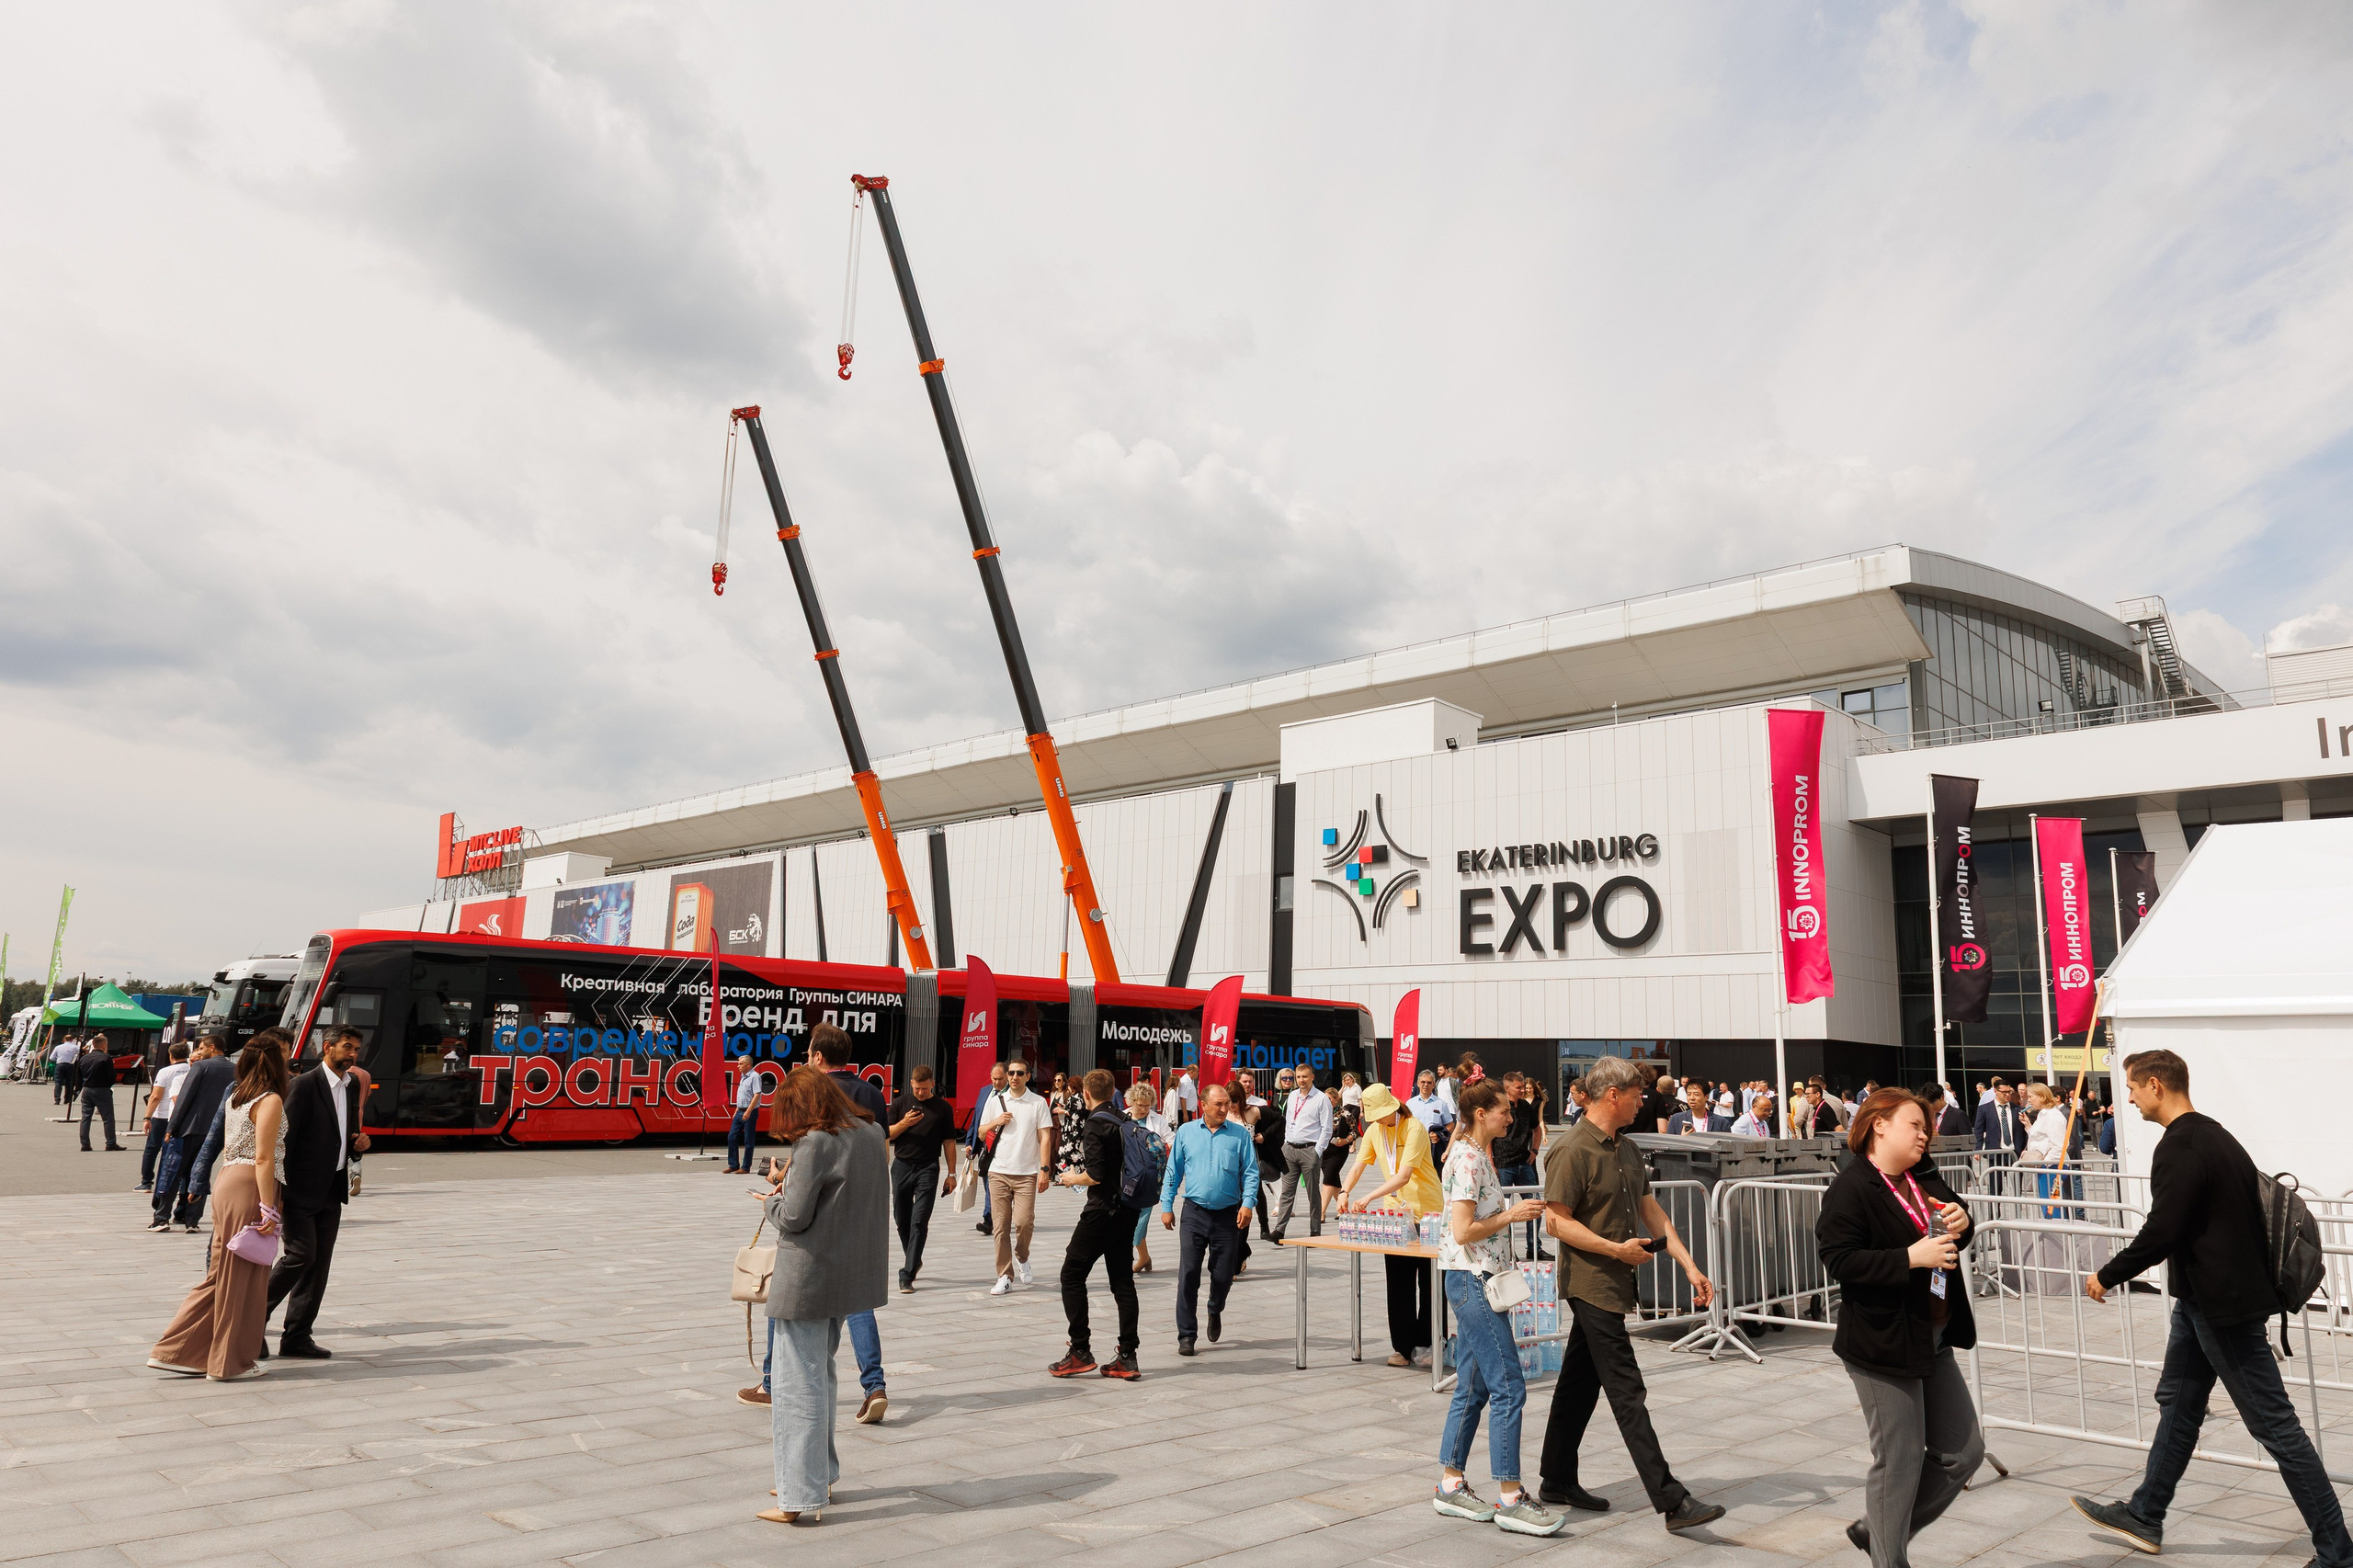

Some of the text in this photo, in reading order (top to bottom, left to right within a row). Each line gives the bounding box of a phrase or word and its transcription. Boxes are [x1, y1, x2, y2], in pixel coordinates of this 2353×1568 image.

[1792, 774, 1812, 901] INNOPROM
[466, 851, 503, 873] ХОЛЛ
[1456, 833, 1658, 873] EKATERINBURG
[1957, 825, 1976, 938] ИННОПРОМ
[677, 915, 695, 932] Сода
[1460, 875, 1661, 954] EXPO
[2059, 861, 2083, 960] ИННОПРОМ
[729, 928, 749, 941] БСК
[561, 973, 665, 994] Креативная
[790, 988, 843, 1005] Группы
[847, 991, 903, 1007] СИНАРА
[963, 1035, 989, 1043] группа
[1101, 1020, 1192, 1044] Молодежь
[1206, 1044, 1228, 1053] группа
